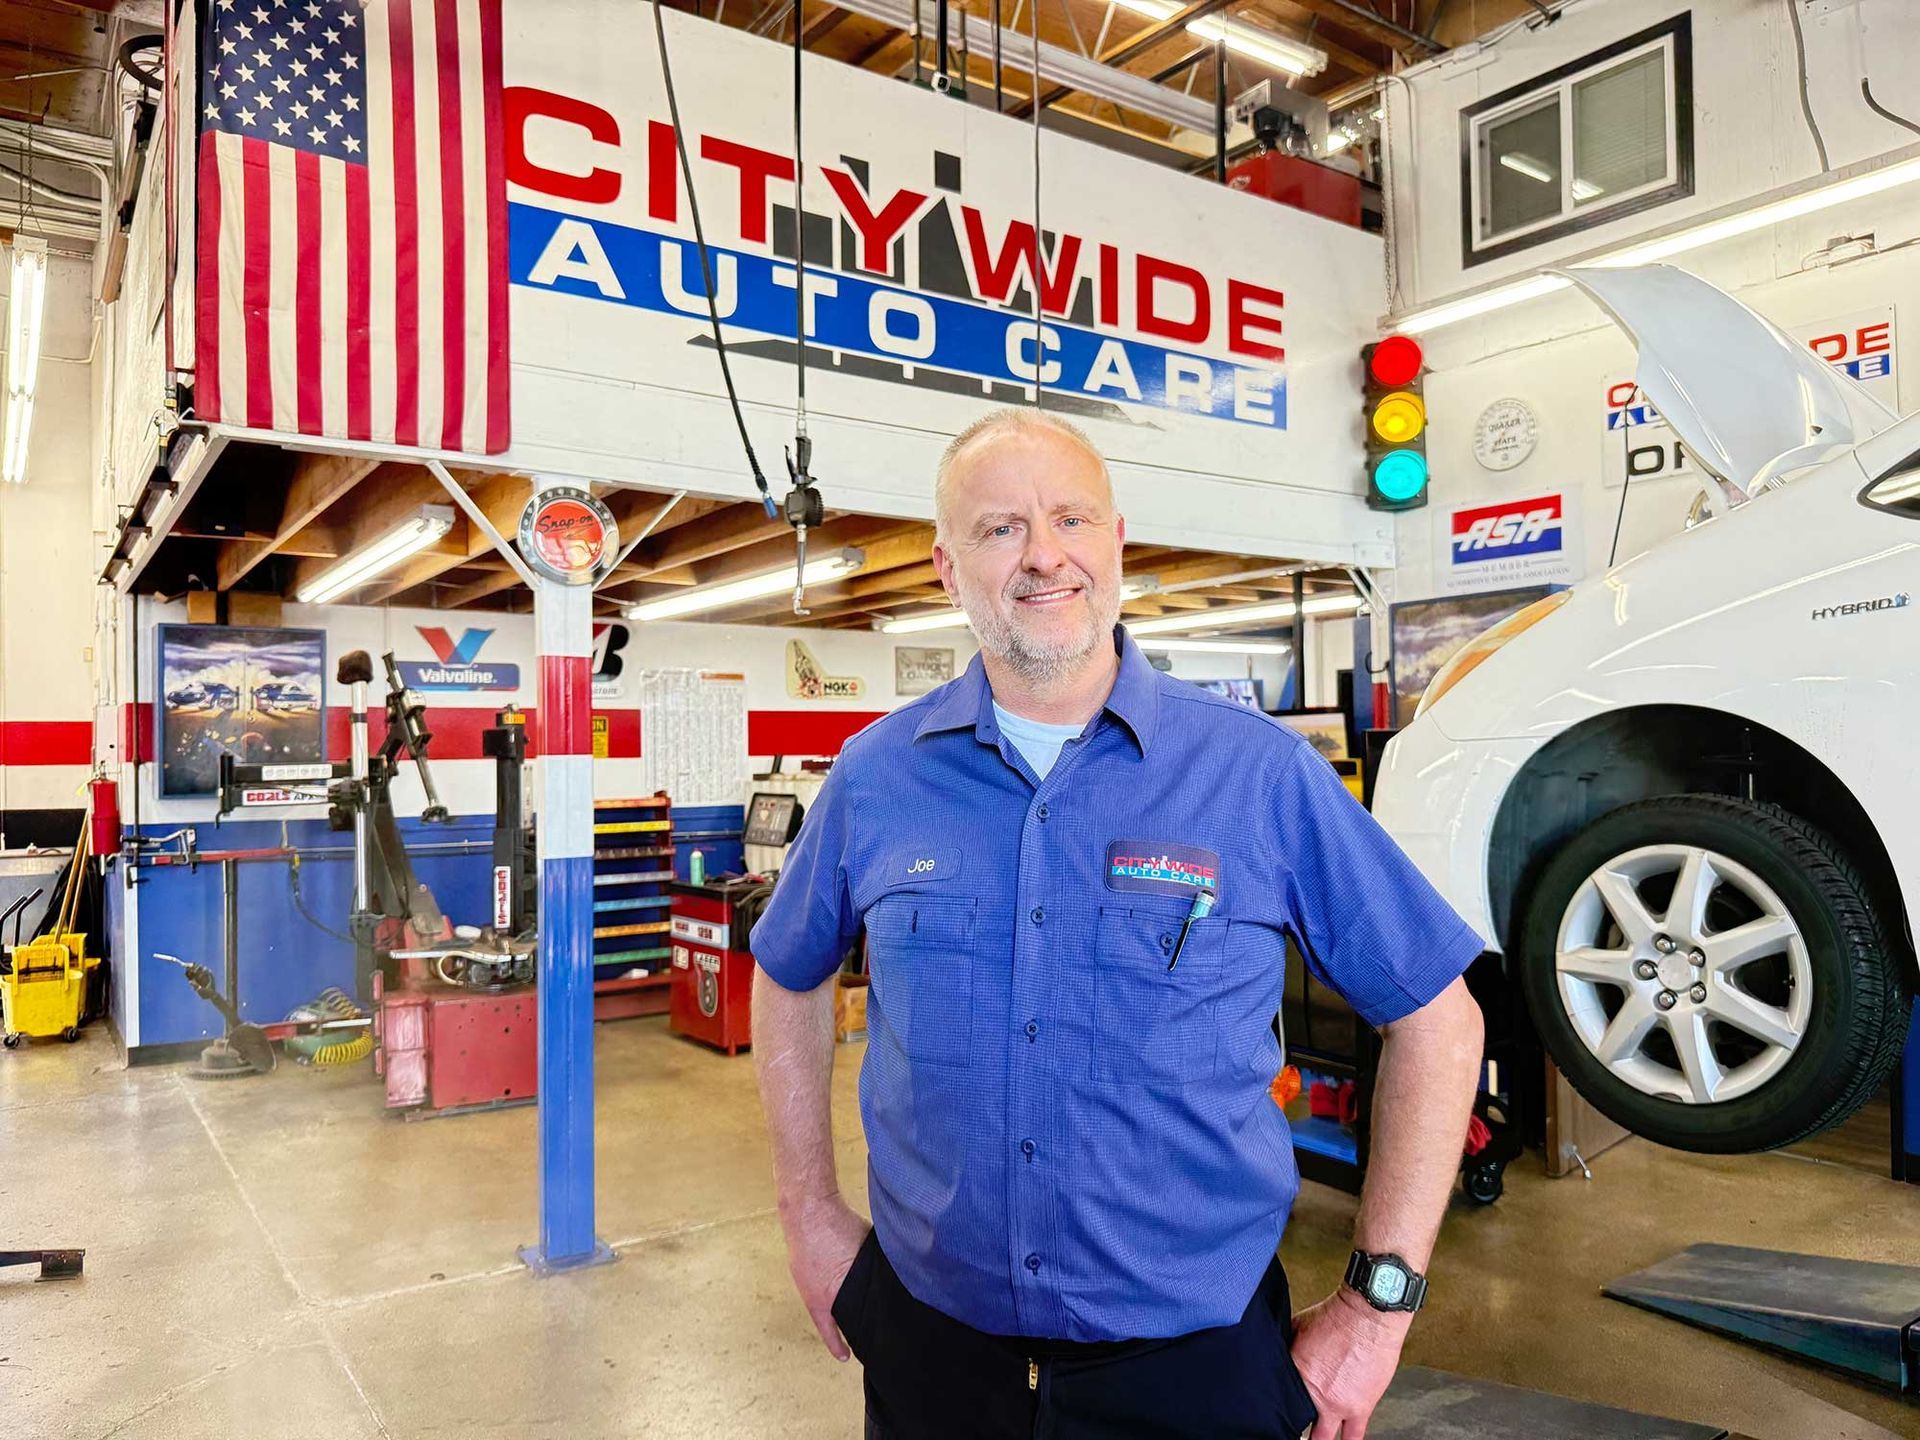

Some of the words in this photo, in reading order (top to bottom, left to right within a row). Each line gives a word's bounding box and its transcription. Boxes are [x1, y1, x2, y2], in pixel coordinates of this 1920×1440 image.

[528, 219, 936, 359] AUTO
[1006, 321, 1276, 425] CARE
[537, 515, 594, 533] Snap-on
[1457, 507, 1556, 552] ASA
[1811, 598, 1893, 620] HYBRID
[418, 668, 495, 683] Valvoline
[824, 682, 849, 692] NGK
[907, 858, 935, 873] Joe
[1116, 866, 1161, 877] AUTO
[1170, 871, 1214, 886] CARE
